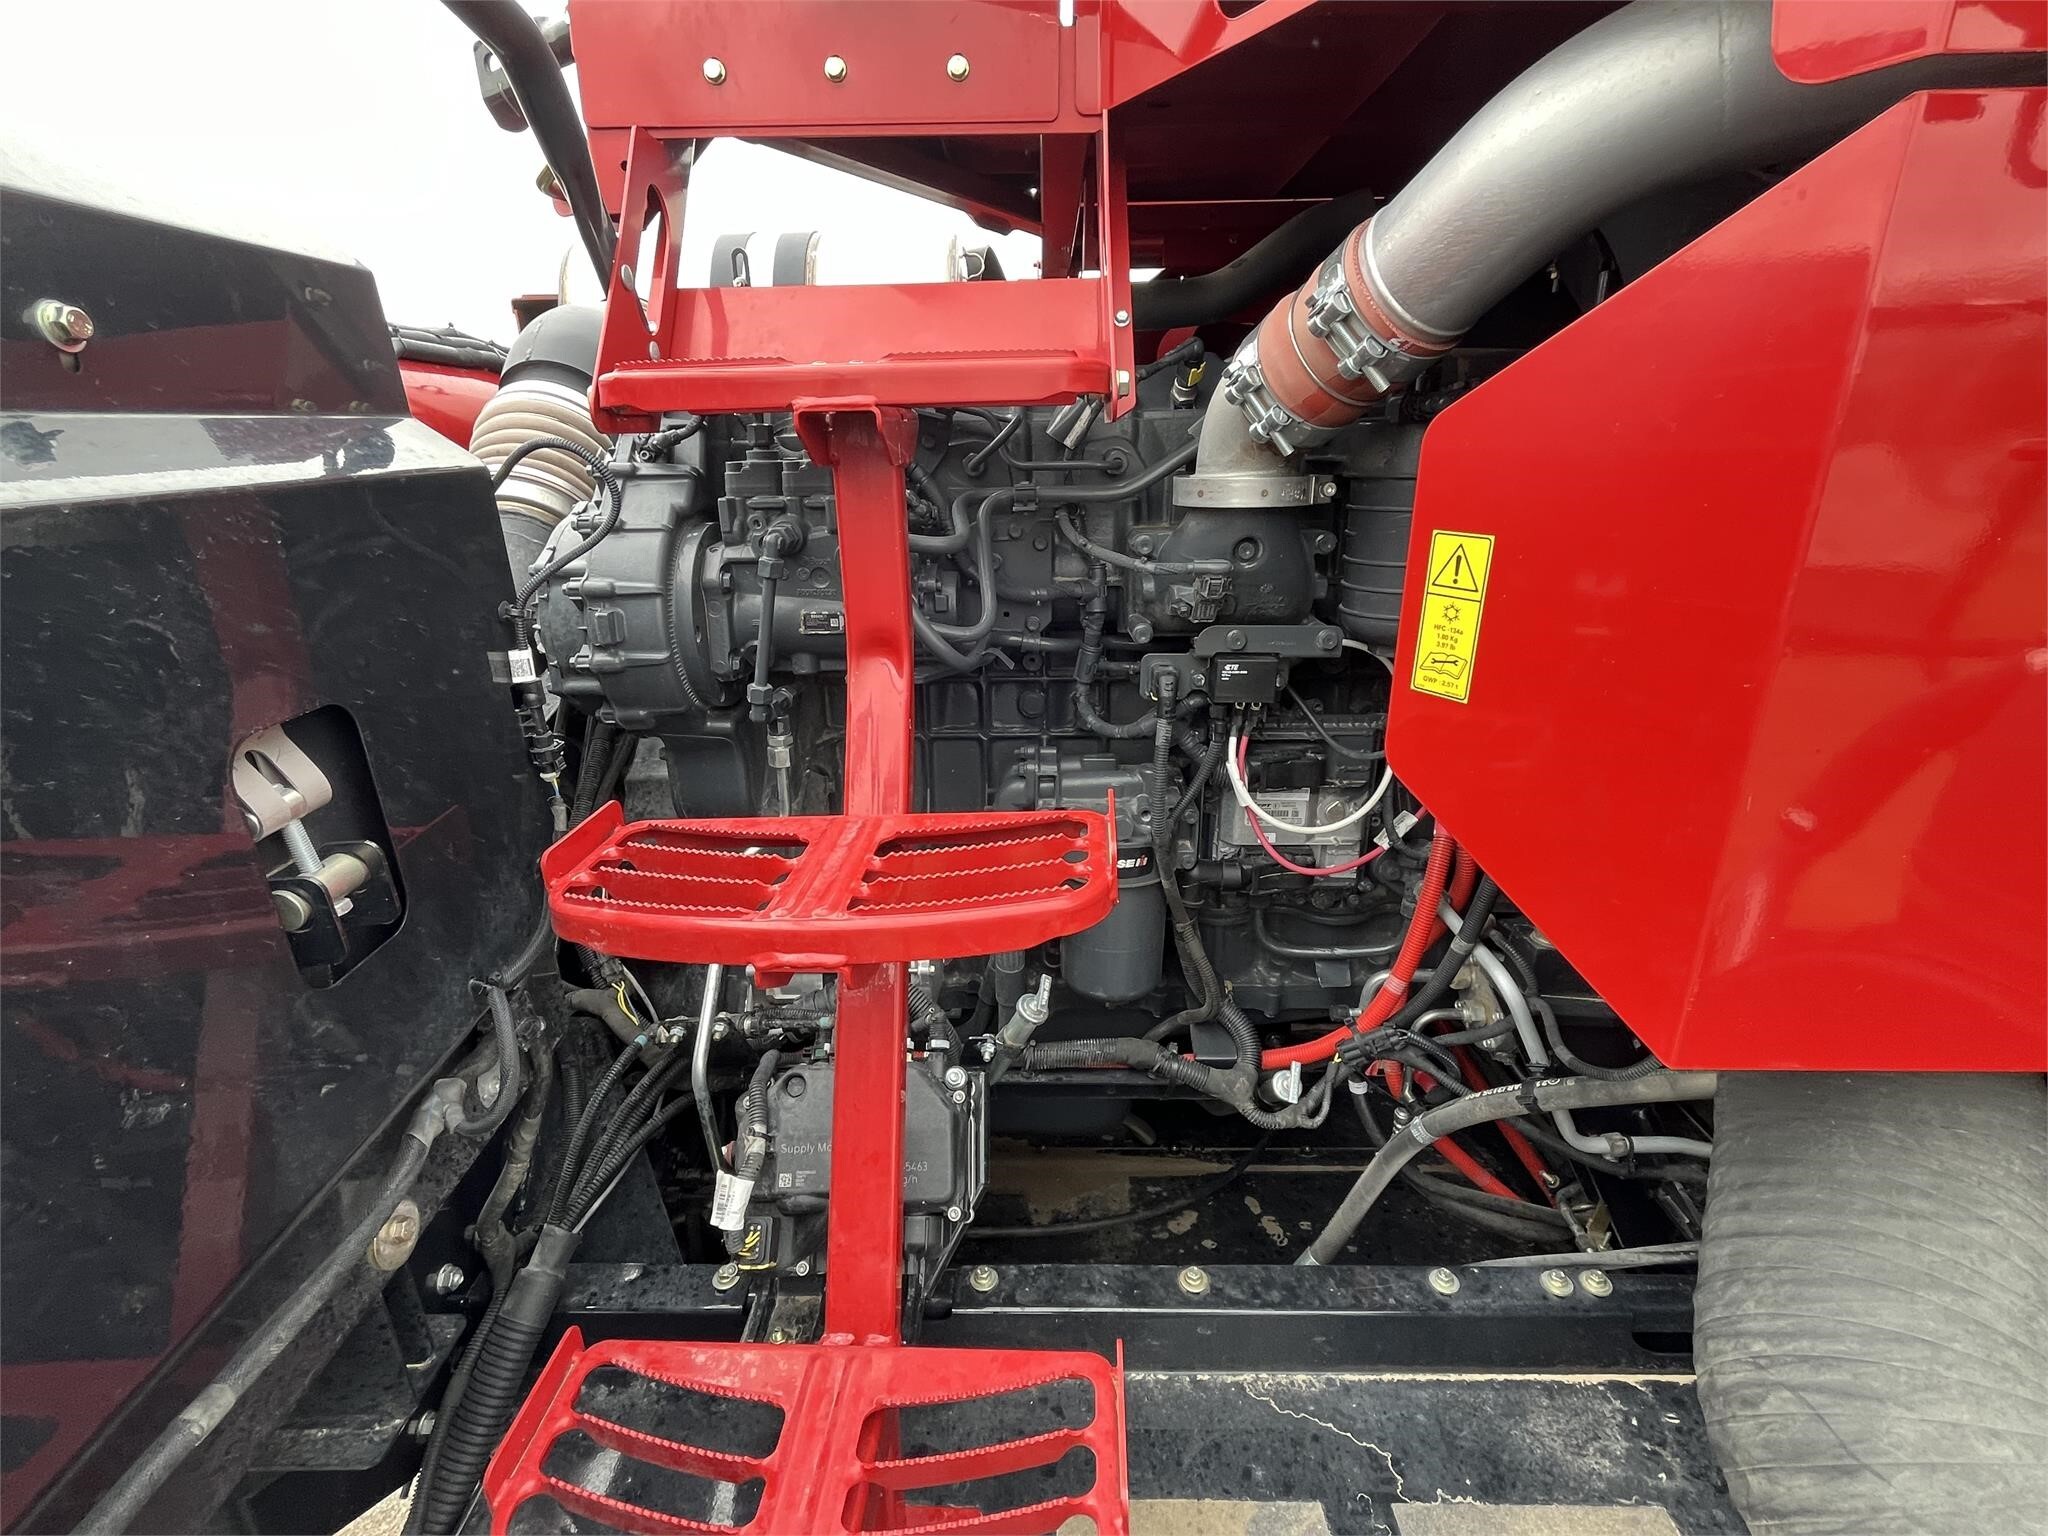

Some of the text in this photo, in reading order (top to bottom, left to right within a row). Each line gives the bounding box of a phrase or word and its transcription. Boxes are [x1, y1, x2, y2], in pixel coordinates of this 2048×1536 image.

[1116, 858, 1136, 869] SE
[780, 1142, 816, 1155] Supply
[904, 1160, 928, 1172] 5463
